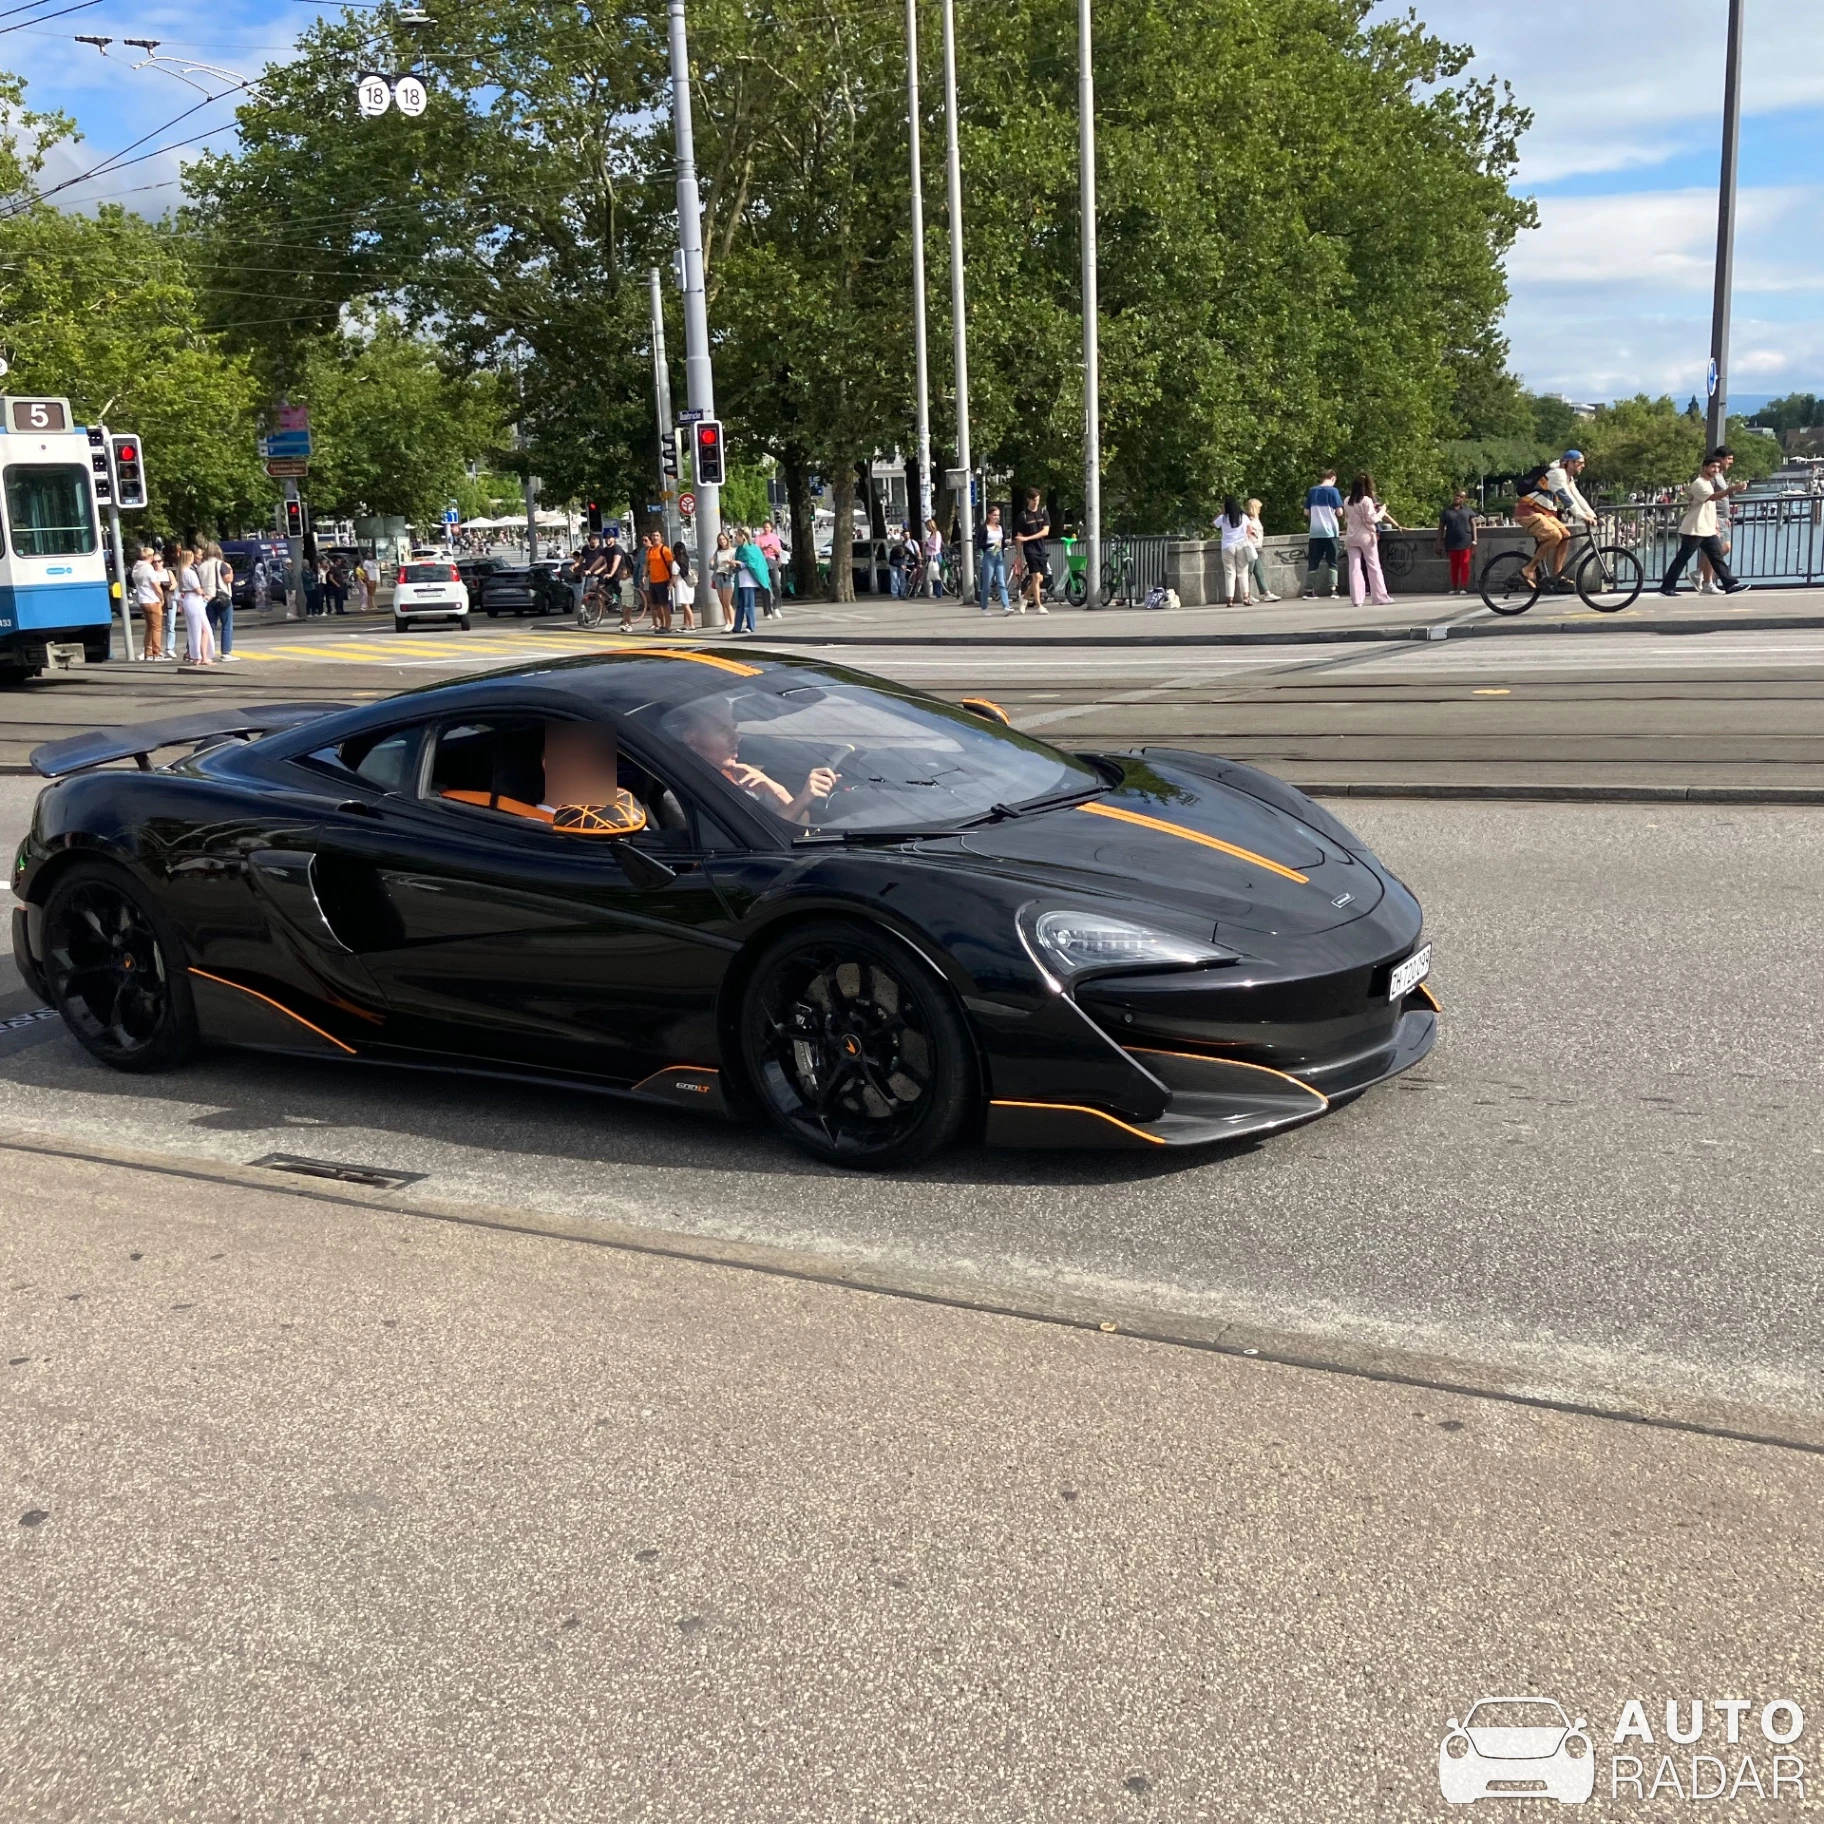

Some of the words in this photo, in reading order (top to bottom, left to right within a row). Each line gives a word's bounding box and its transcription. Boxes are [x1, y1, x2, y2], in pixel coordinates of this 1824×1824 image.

[366, 87, 383, 104] 18
[402, 88, 420, 105] 18
[31, 403, 49, 428] 5
